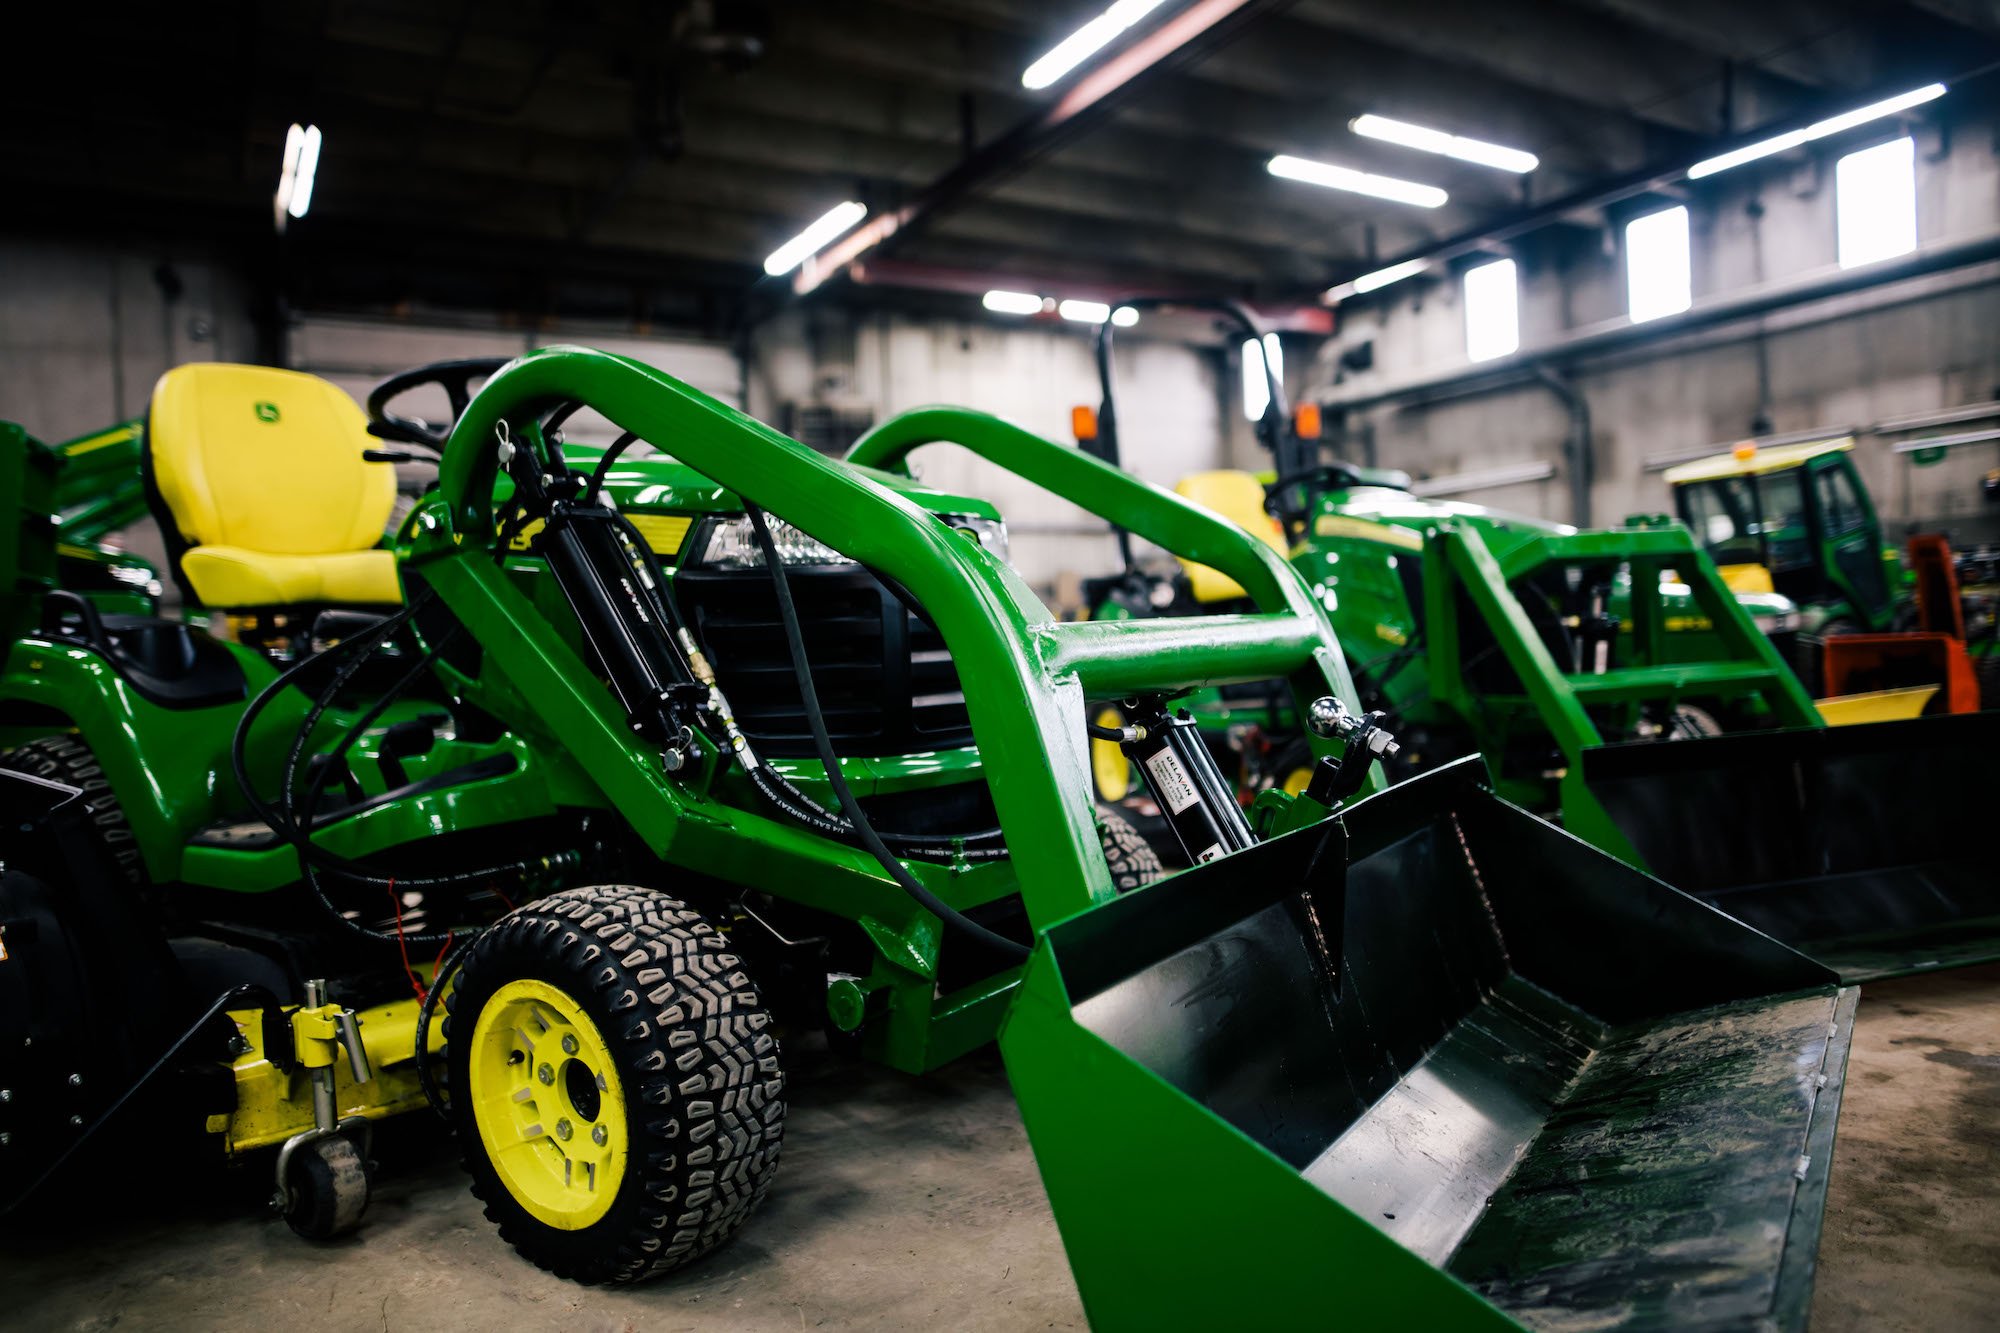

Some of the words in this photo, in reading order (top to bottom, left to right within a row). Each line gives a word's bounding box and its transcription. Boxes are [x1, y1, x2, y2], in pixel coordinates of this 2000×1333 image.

[1166, 756, 1192, 796] DELAVAN
[752, 772, 778, 801] 5000PSI
[782, 780, 800, 796] MSHA
[776, 800, 811, 823] 100R2AT
[825, 812, 838, 823] W/P
[814, 818, 831, 830] SAE
[832, 825, 845, 834] 1/4
